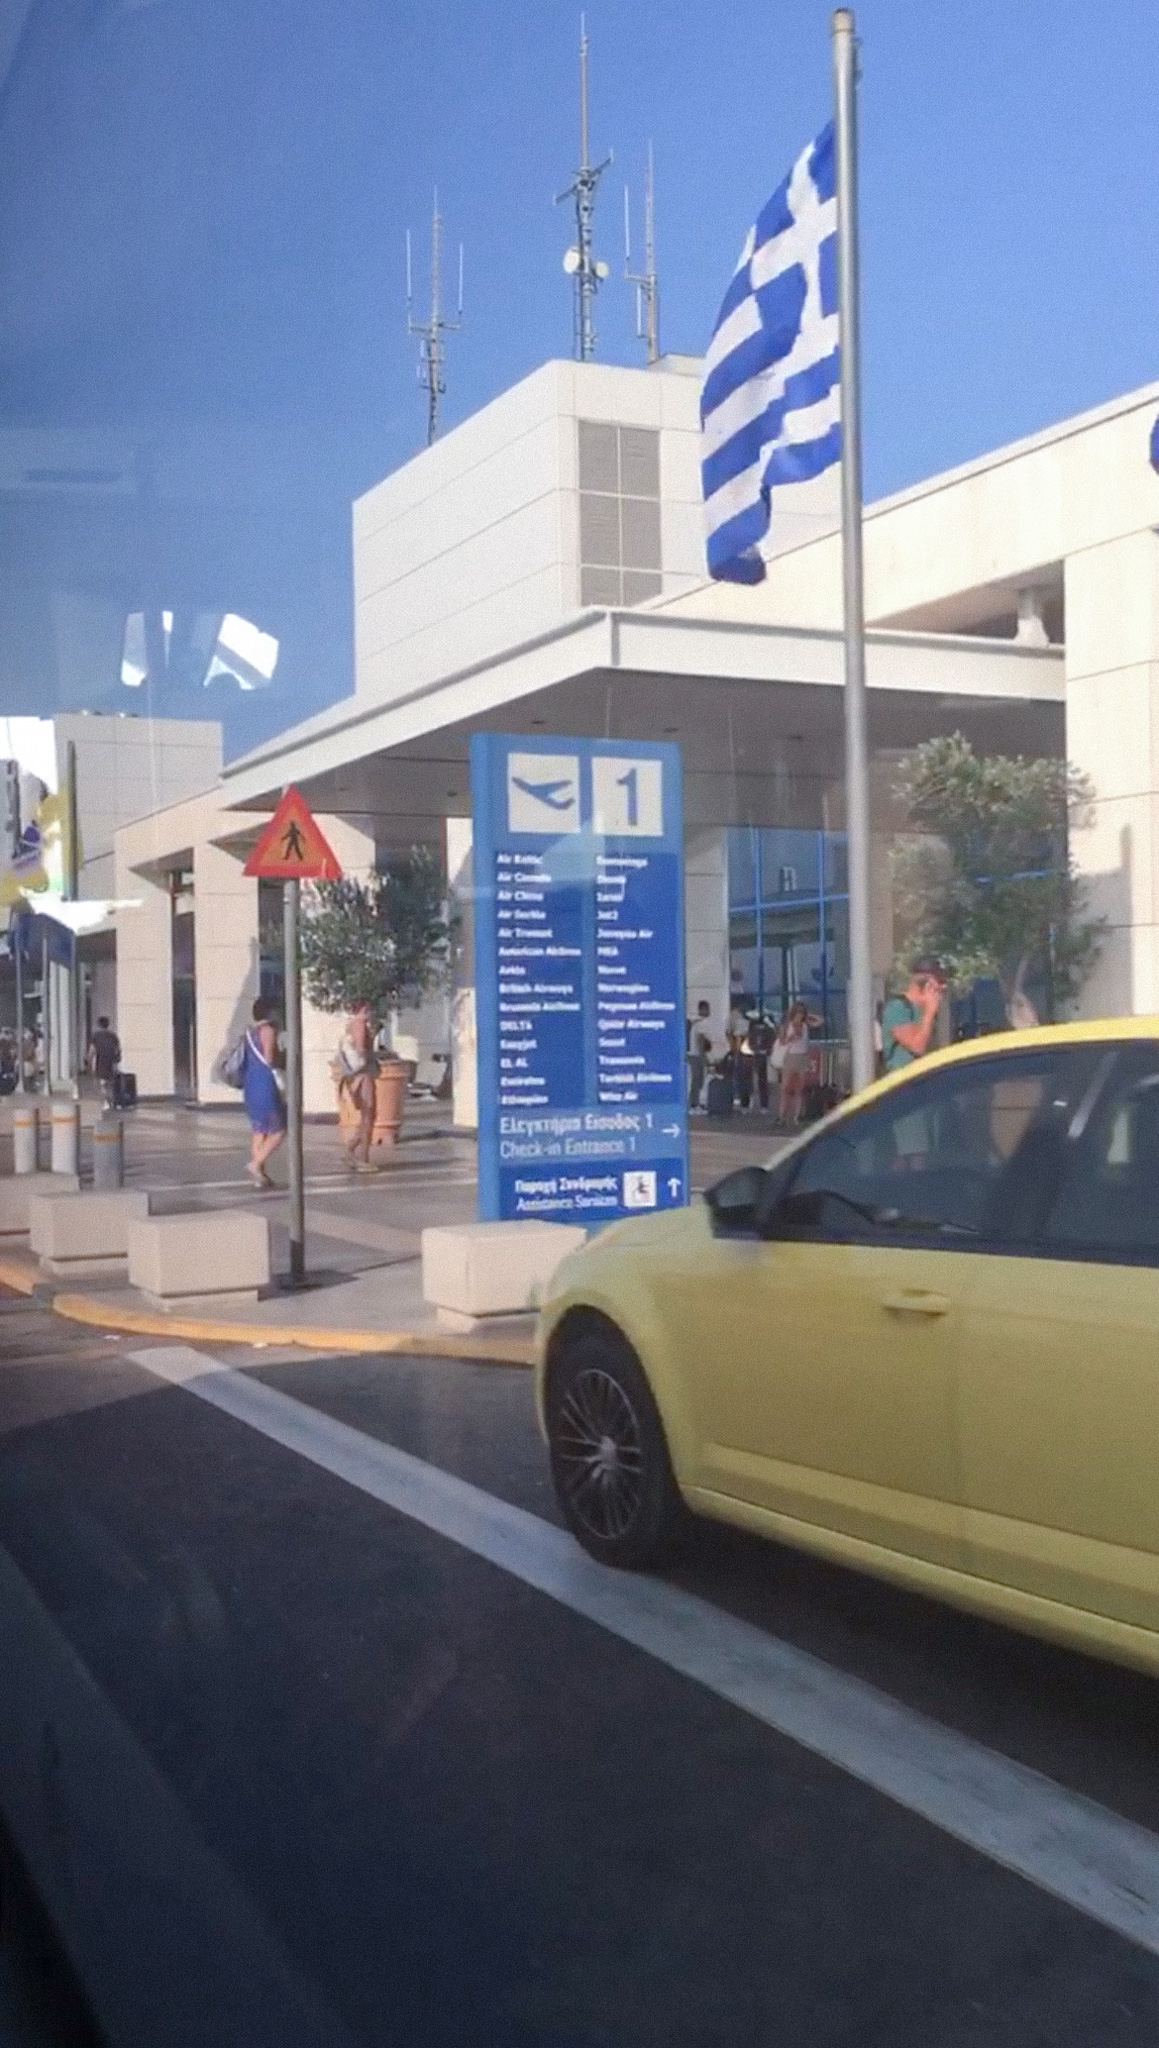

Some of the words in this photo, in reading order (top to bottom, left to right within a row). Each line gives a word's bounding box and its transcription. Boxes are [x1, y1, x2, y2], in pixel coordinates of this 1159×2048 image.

[616, 767, 638, 826] 1
[500, 1020, 533, 1031] DELTA
[645, 1113, 653, 1129] 1
